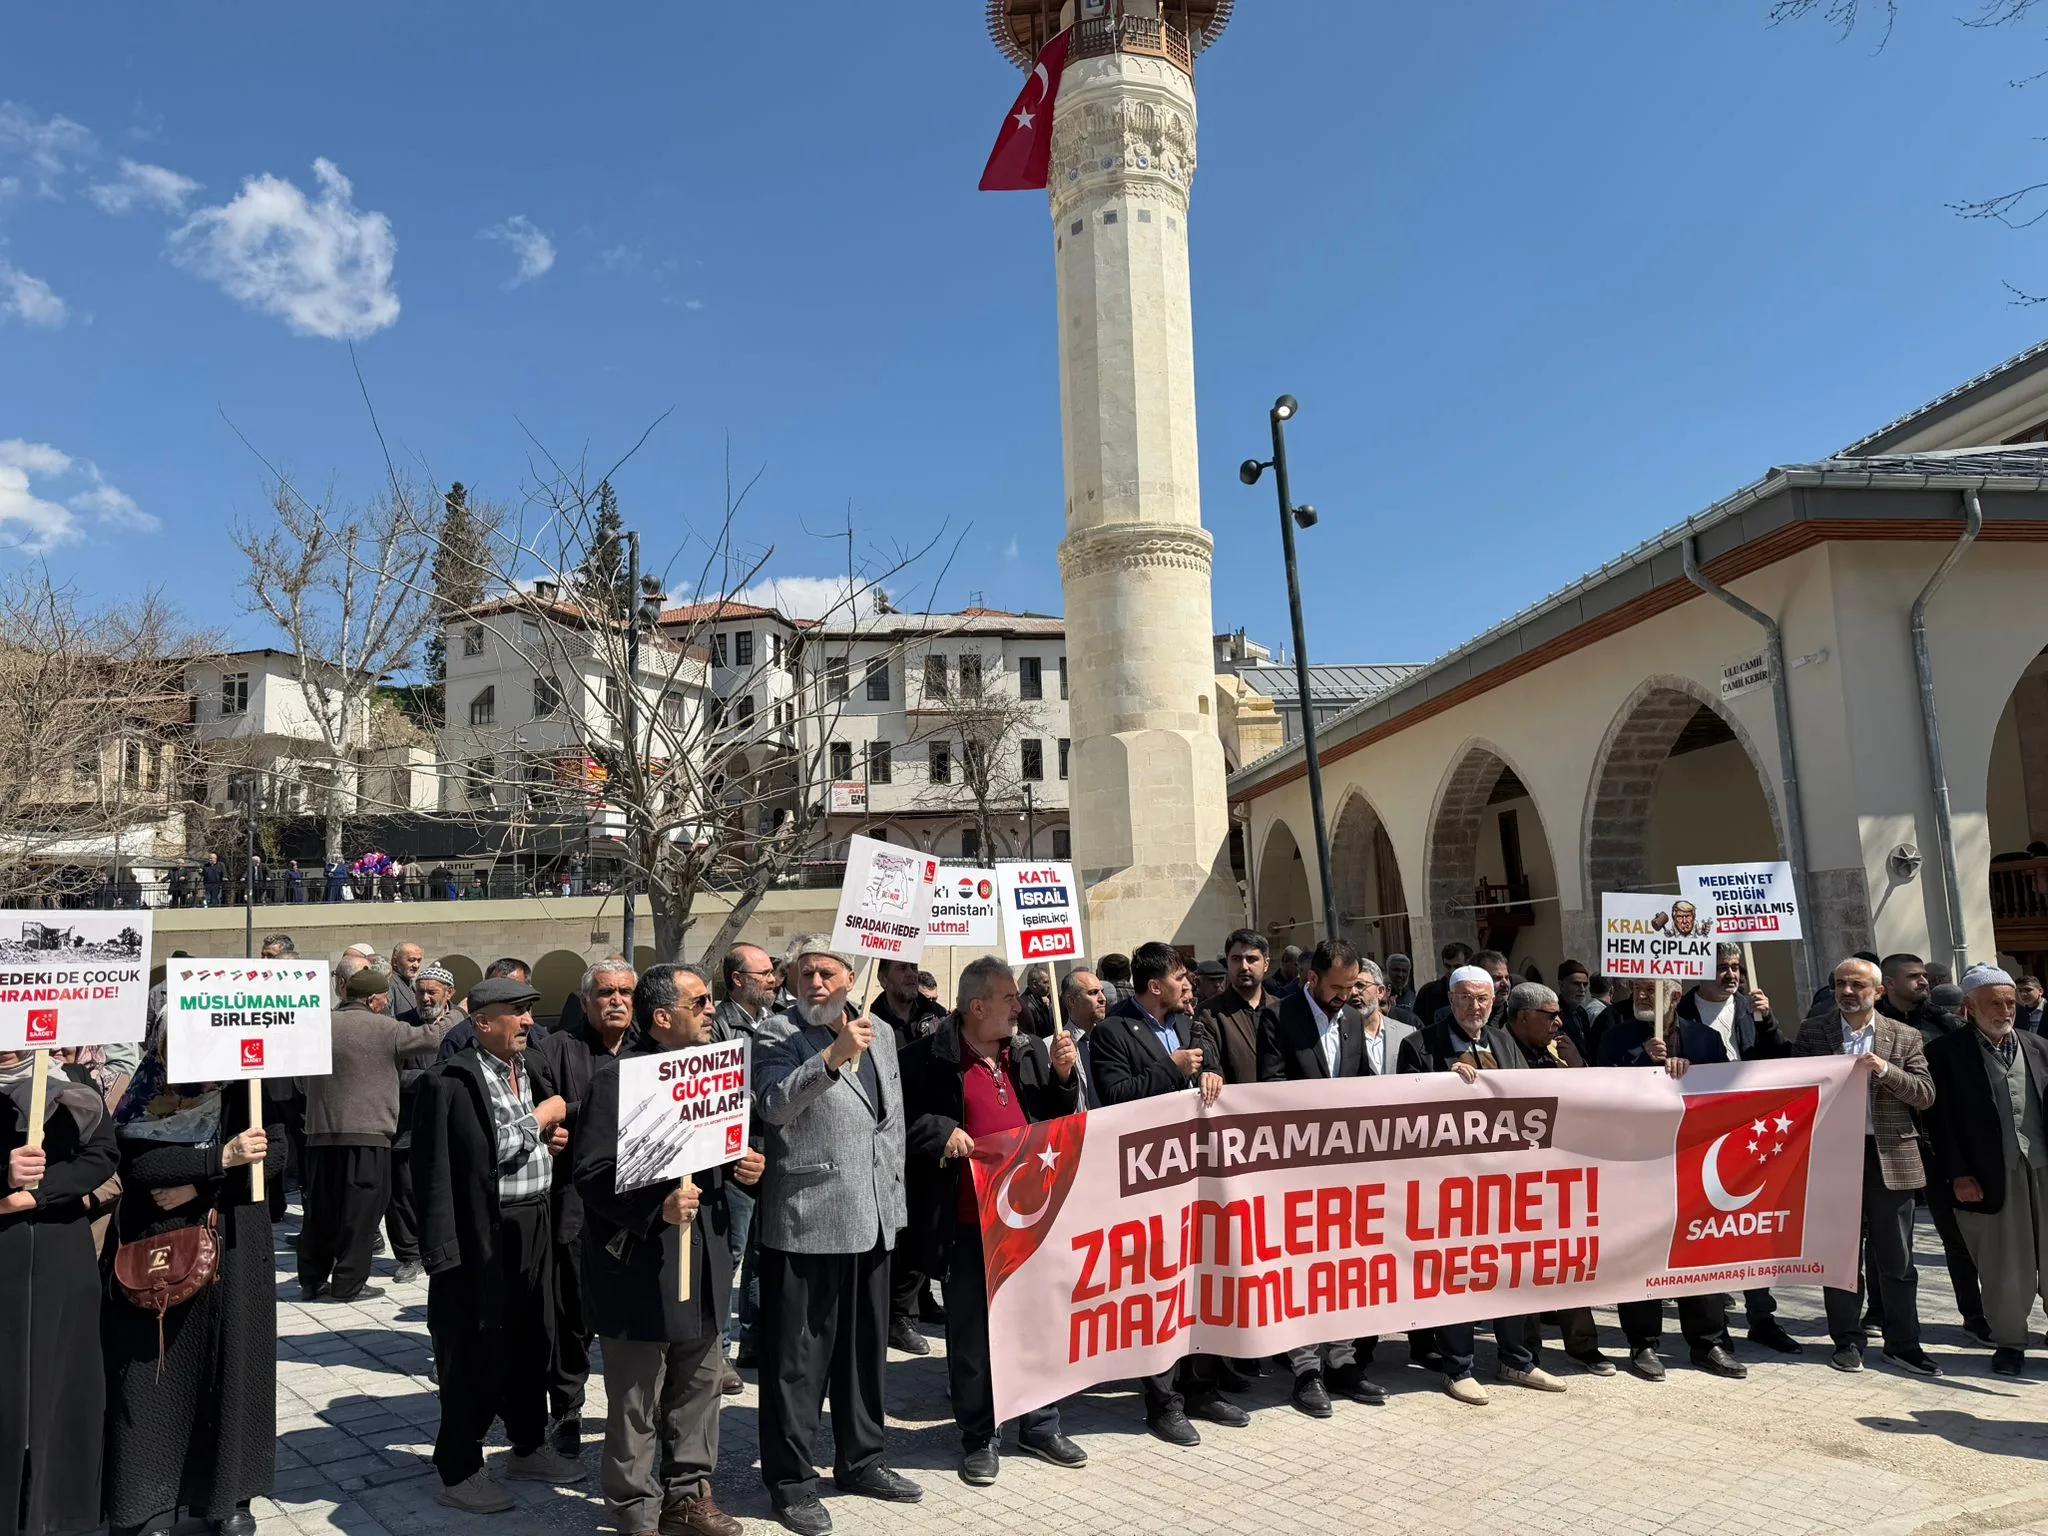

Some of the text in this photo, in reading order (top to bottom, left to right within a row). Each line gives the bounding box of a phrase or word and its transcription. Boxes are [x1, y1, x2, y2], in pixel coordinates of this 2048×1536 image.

[1724, 665, 1740, 678] ULU
[1745, 670, 1768, 685] KEBİR
[1018, 867, 1061, 884] KATİL
[1699, 872, 1773, 887] MEDENİYET
[934, 886, 949, 898] k'ı
[1019, 888, 1066, 906] İSRAİL
[931, 903, 994, 917] ganistan'ı
[1716, 902, 1795, 917] DİŞİ KALMIŞ
[845, 914, 920, 939] SIRADAKİ HEDEF
[928, 920, 969, 933] utma!
[1022, 911, 1069, 927] İŞBİRLİKÇİ
[1607, 918, 1655, 934] KRAL
[861, 933, 902, 952] TÜRKİYE!
[1028, 934, 1071, 953] ABD!
[1607, 938, 1712, 959] HEM ÇIPLAK
[1607, 958, 1704, 976] HEM KATİL!
[0, 970, 140, 986] EDEKİ DE ÇOCUK
[0, 986, 119, 1003] HRANDAKİ DE!
[180, 992, 320, 1010] MÜSLÜMANLAR
[211, 1011, 296, 1028] BİRLEŞİN!
[658, 1047, 745, 1081] SİYONİZM
[672, 1069, 745, 1102] GÜÇTEN
[679, 1091, 744, 1122] ANLAR!
[1126, 1108, 1548, 1186] KAHRAMANMARAŞ
[1686, 1210, 1791, 1241] SAADET
[1071, 1166, 1599, 1304] ZALİMLERE LANET!
[1646, 1263, 1825, 1288] KAHRAMANMARAŞ İL BAŞKANLIĞI
[1068, 1235, 1599, 1364] MAZLUMLARA DESTEK!
